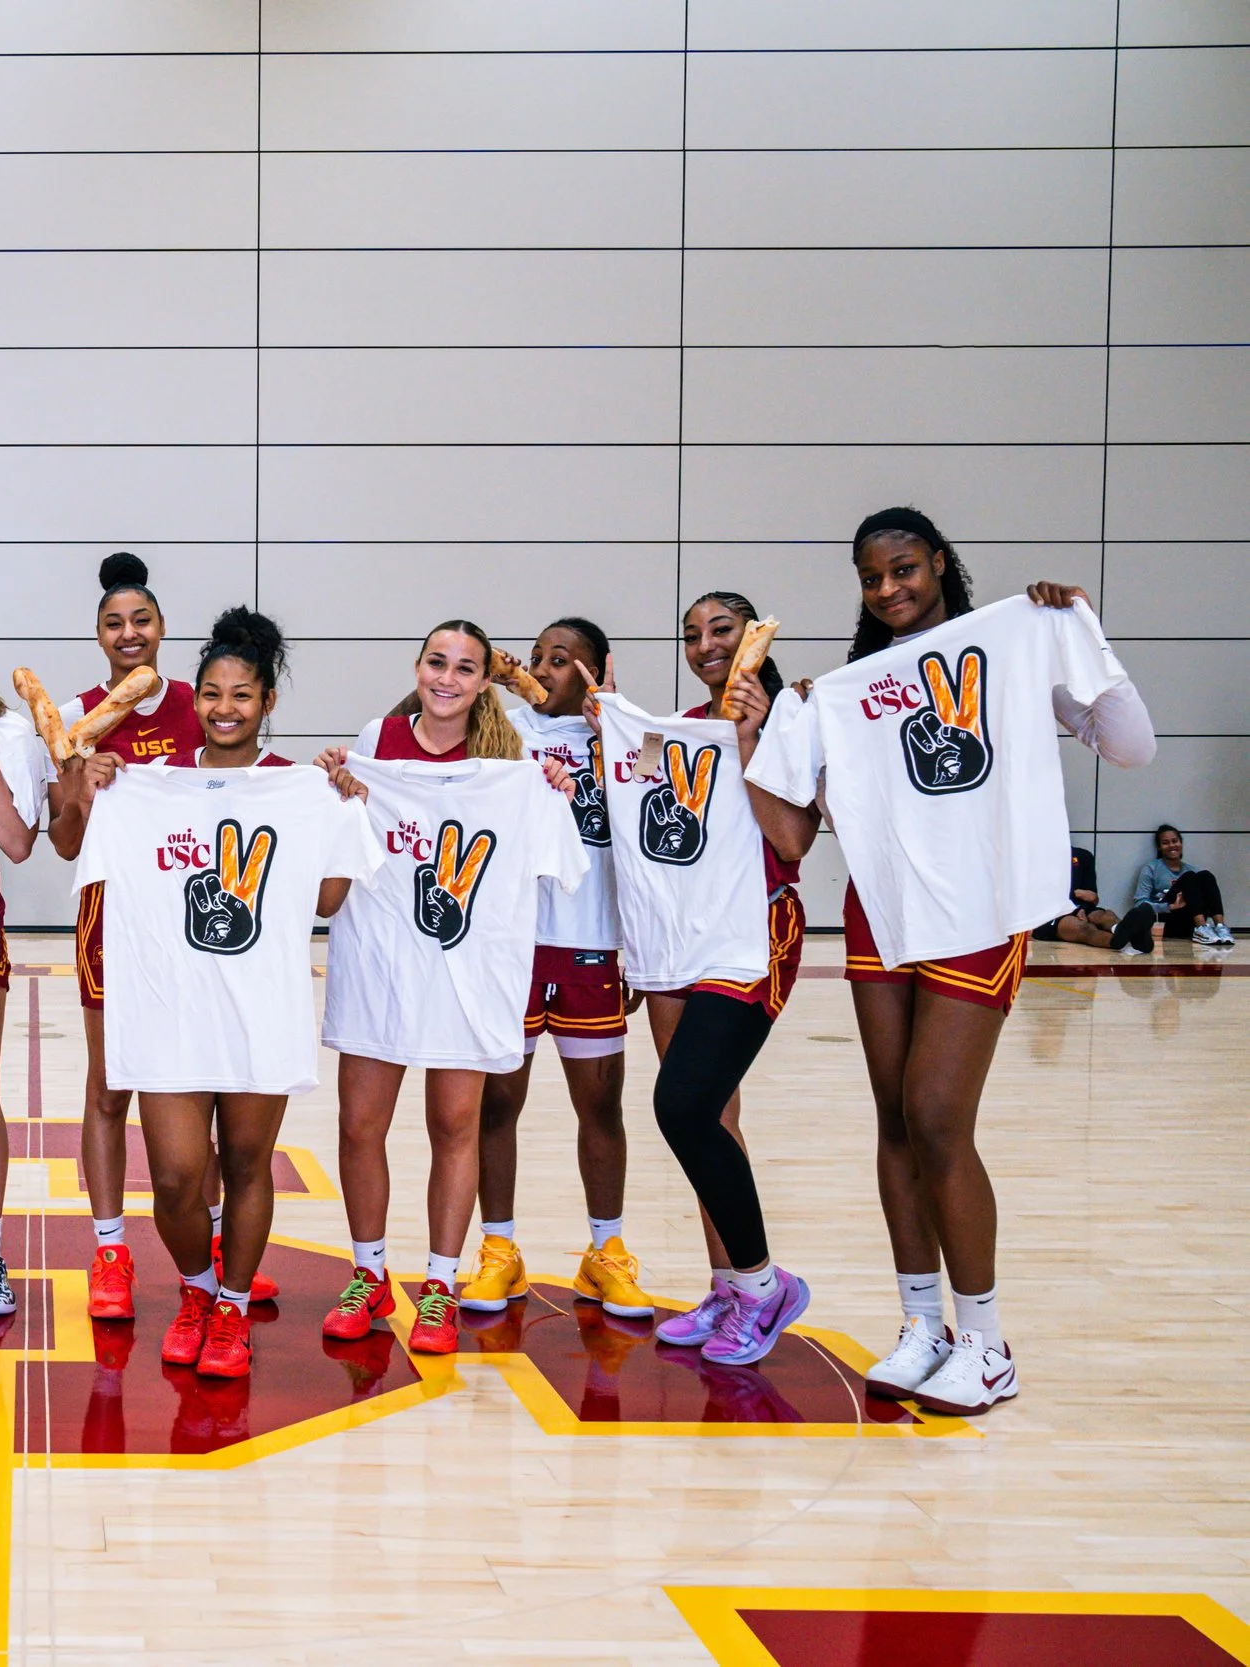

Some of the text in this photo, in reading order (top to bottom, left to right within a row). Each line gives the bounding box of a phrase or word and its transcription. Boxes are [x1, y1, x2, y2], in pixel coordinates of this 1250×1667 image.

[869, 673, 901, 692] oui,
[860, 684, 922, 720] USC
[131, 738, 177, 756] USC
[167, 828, 197, 844] oui,
[156, 844, 211, 871] USC
